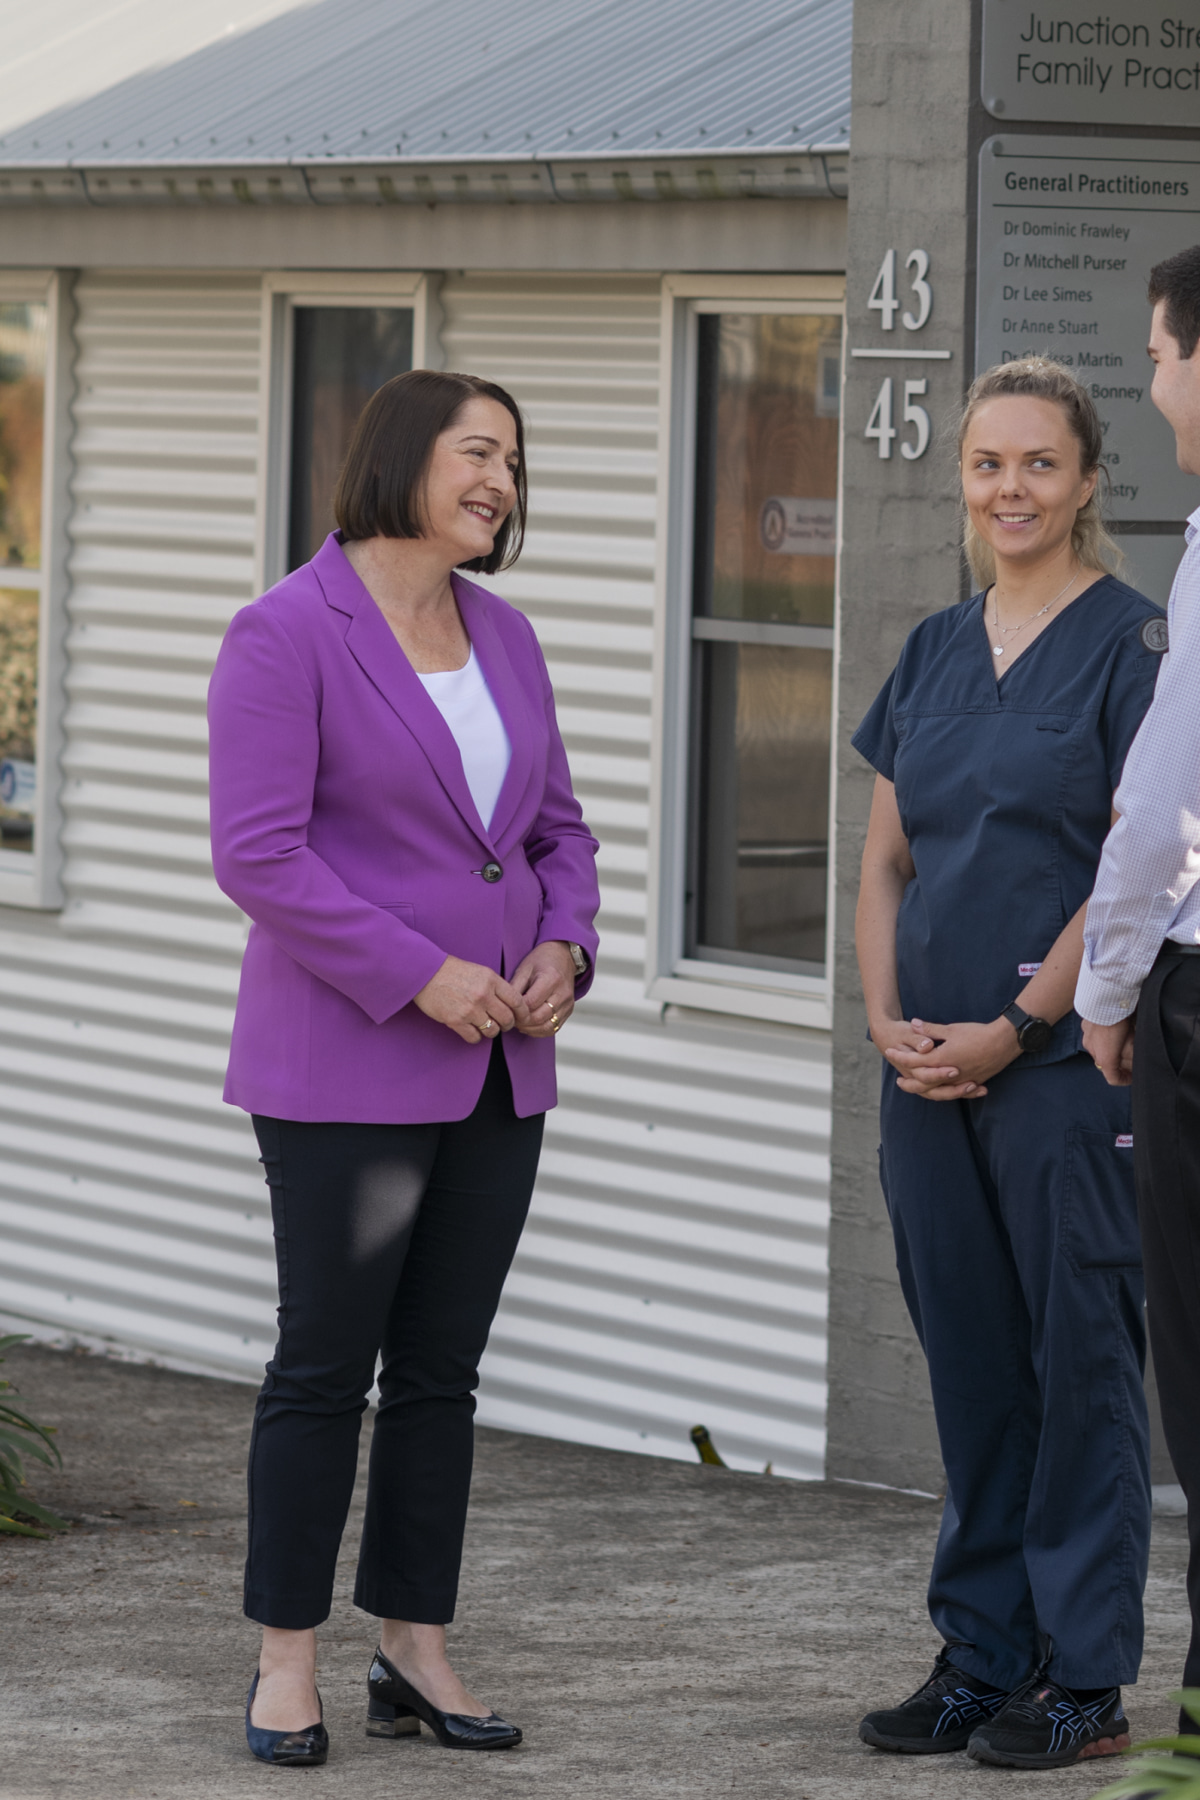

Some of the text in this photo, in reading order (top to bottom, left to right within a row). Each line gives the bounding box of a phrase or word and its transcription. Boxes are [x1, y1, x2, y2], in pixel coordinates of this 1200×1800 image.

[1020, 13, 1149, 48] Junction
[1017, 53, 1113, 93] Family
[1005, 171, 1189, 196] General Practitioners
[1004, 221, 1130, 241] Dr Dominic Frawley
[1003, 252, 1126, 270] Dr Mitchell Purser
[868, 249, 932, 330] 43
[1003, 286, 1093, 302] Dr Lee Simes
[1002, 318, 1098, 335] Dr Anne Stuart
[1078, 352, 1123, 367] Martin
[1092, 384, 1143, 402] Bonney
[865, 377, 930, 460] 45
